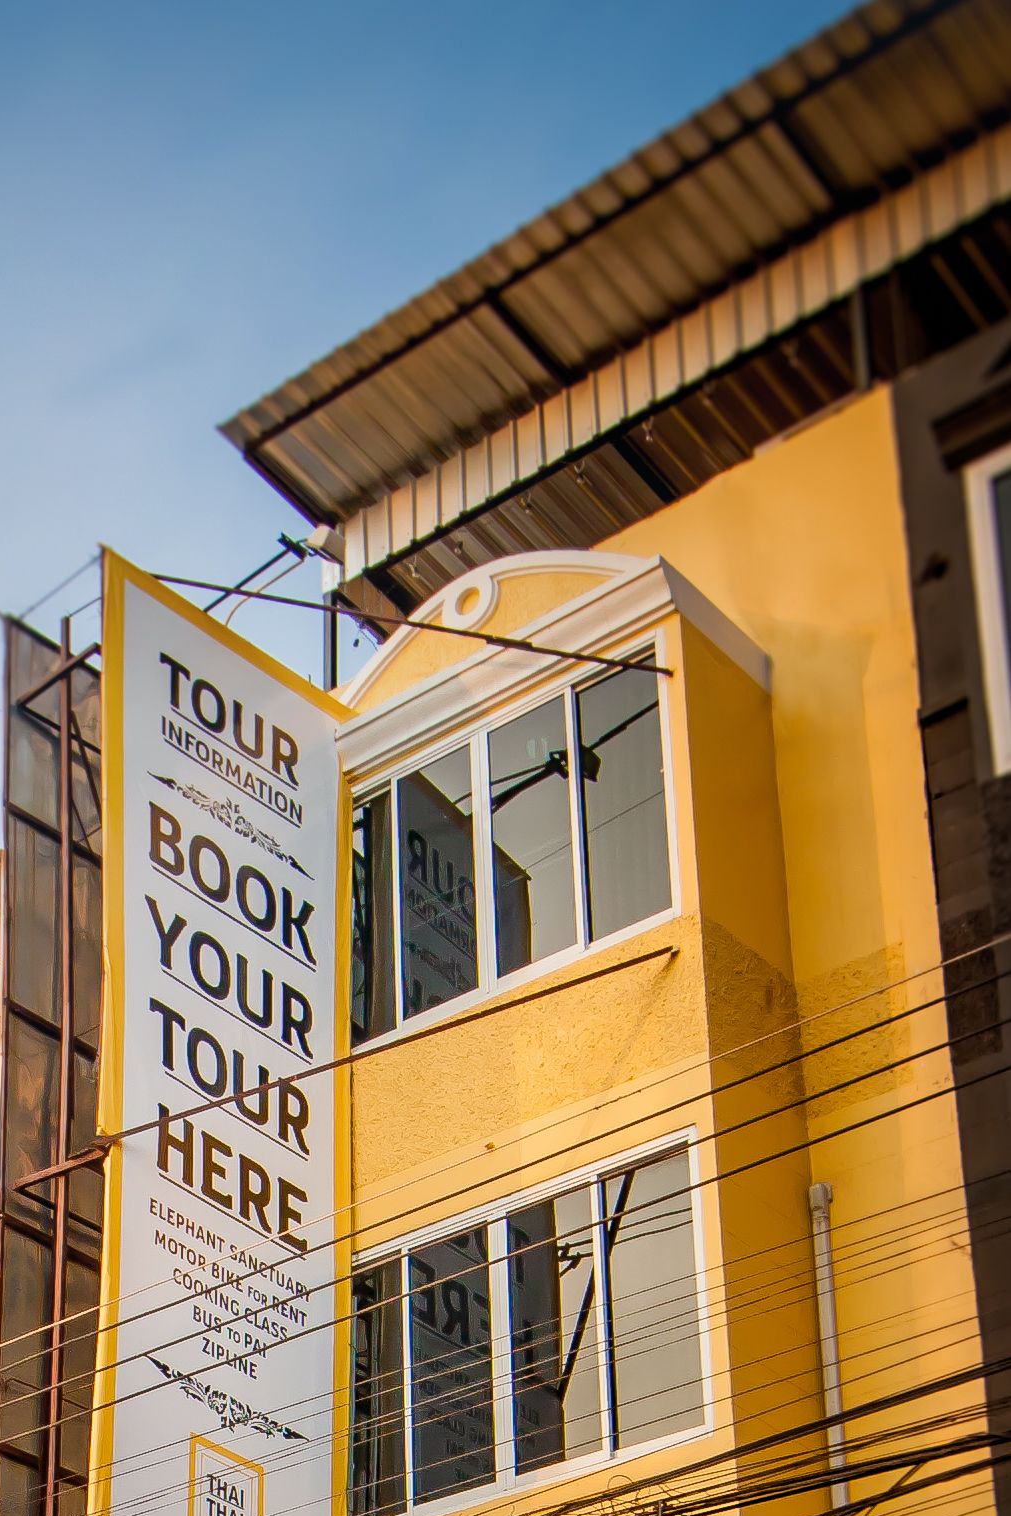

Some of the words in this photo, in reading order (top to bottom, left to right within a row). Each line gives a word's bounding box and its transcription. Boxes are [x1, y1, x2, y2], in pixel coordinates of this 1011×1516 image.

[160, 652, 299, 786] TOUR
[162, 716, 302, 824] INFORMATION
[149, 801, 316, 965] BOOK
[145, 894, 313, 1059] YOUR
[149, 997, 309, 1155] TOUR
[157, 1103, 308, 1251] HERE
[150, 1198, 225, 1252] ELEPHANT
[230, 1245, 310, 1302] SANCTUARY
[155, 1230, 206, 1271] MOTOR
[212, 1262, 243, 1293] BIKE
[248, 1286, 267, 1306] FOR
[273, 1295, 307, 1327] RENT
[173, 1268, 239, 1315] COOKING
[245, 1308, 288, 1341] CLASS
[193, 1305, 222, 1333] BUS
[227, 1327, 240, 1343] TO
[245, 1333, 266, 1358] PAI
[202, 1337, 257, 1379] ZIPLINE
[207, 1474, 244, 1508] THAI
